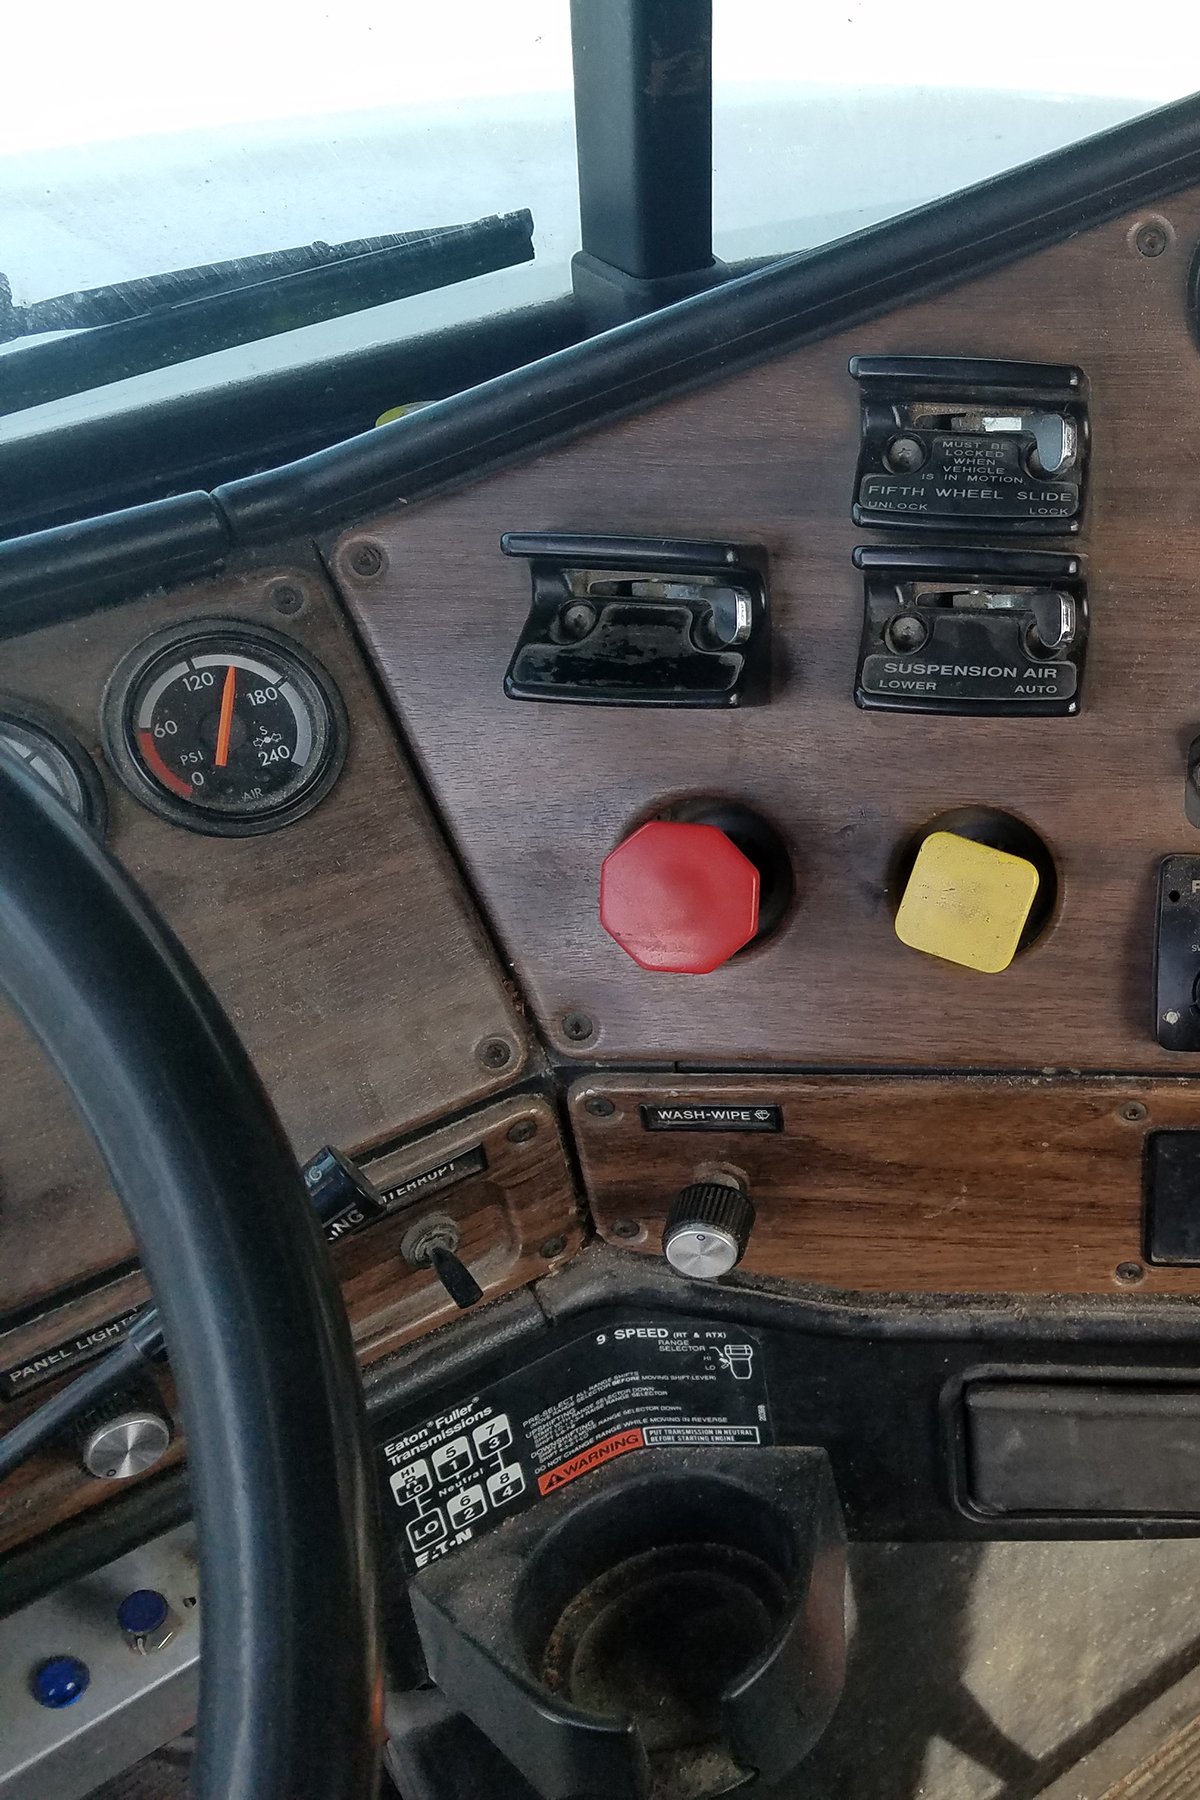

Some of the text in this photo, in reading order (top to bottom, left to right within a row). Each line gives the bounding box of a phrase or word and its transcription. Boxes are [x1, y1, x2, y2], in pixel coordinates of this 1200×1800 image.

[946, 450, 1004, 458] LOCKED
[943, 466, 1005, 474] VEHICLE
[967, 475, 1023, 483] MOTION
[868, 486, 1072, 501] FIFTH WHEEL SLIDE
[868, 501, 927, 510] UNLOCK
[884, 663, 1057, 678] SUSPENSION AIR
[182, 672, 278, 706] 120 180
[879, 680, 936, 690] LOWER
[1015, 685, 1057, 694] AUTO
[154, 720, 177, 738] 60
[180, 746, 290, 766] PSI 240
[192, 772, 204, 786] 0
[658, 1110, 750, 1120] WASH-WIPE
[597, 1328, 669, 1345] 9 SPEED
[10, 1350, 72, 1382] PANEL
[388, 1406, 493, 1466] Transmissions
[485, 1424, 496, 1436] 7
[595, 1424, 621, 1439] RANGE
[489, 1437, 500, 1449] 3
[446, 1446, 457, 1459] 5
[563, 1434, 638, 1475] WARNING
[401, 1466, 416, 1479] HI
[500, 1473, 510, 1484] 8
[438, 1468, 484, 1497] Neutral
[502, 1485, 513, 1497] 4
[460, 1495, 471, 1506] 6
[463, 1508, 475, 1520] 2
[414, 1520, 438, 1541] LO
